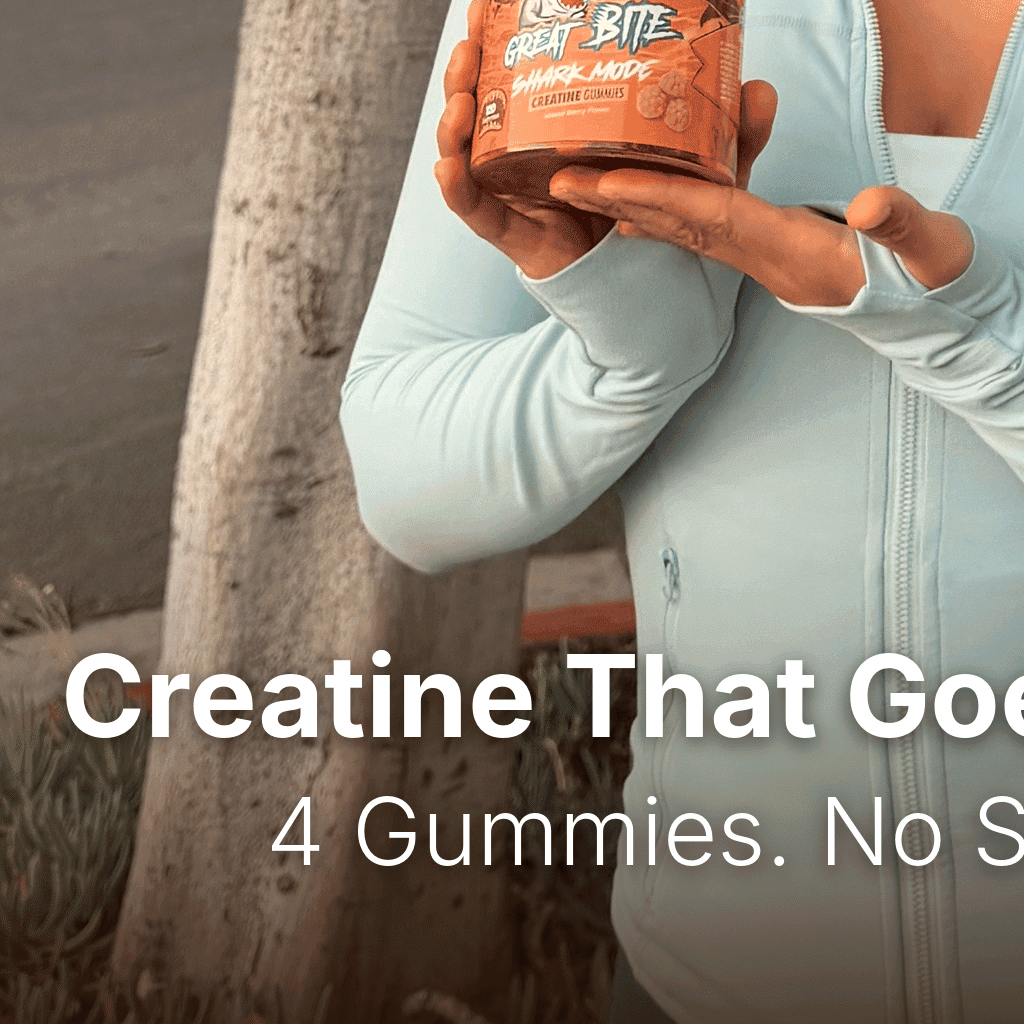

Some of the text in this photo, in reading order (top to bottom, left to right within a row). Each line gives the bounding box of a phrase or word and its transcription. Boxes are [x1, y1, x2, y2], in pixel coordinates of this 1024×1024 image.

[504, 21, 589, 69] GREAT
[511, 59, 661, 98] SHARK MODE
[531, 90, 581, 108] CREATINE
